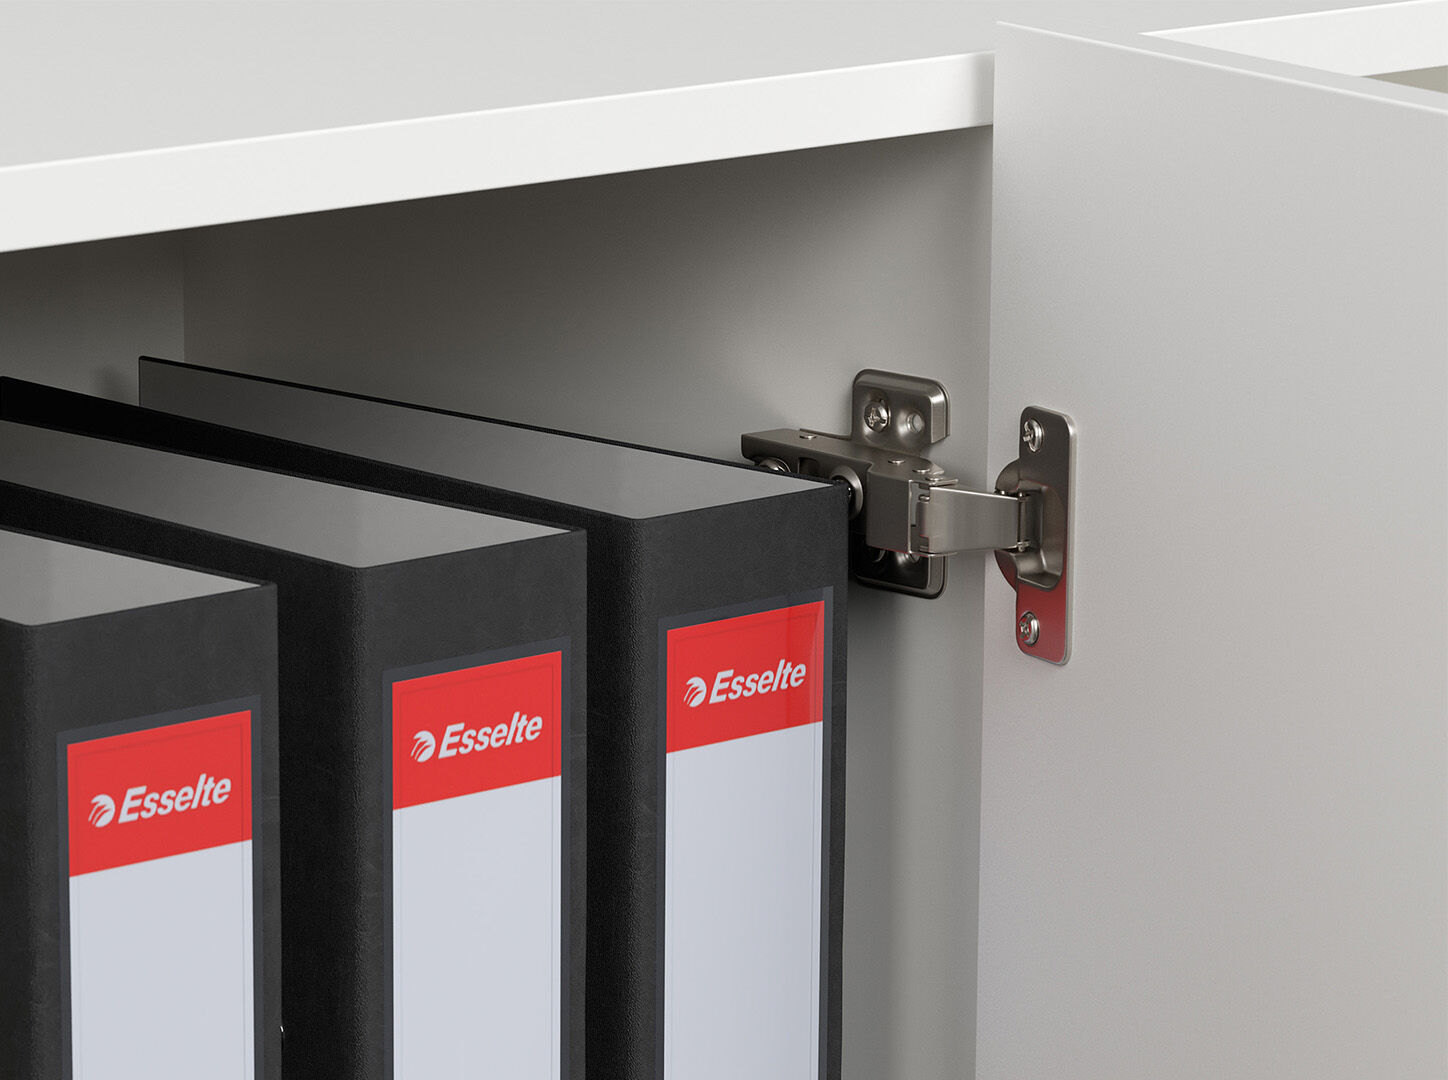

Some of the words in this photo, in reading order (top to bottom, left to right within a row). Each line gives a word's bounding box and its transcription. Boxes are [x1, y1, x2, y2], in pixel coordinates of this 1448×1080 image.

[708, 658, 807, 705] Esselte
[437, 711, 543, 760] Esselte
[117, 773, 232, 824] Esselte
